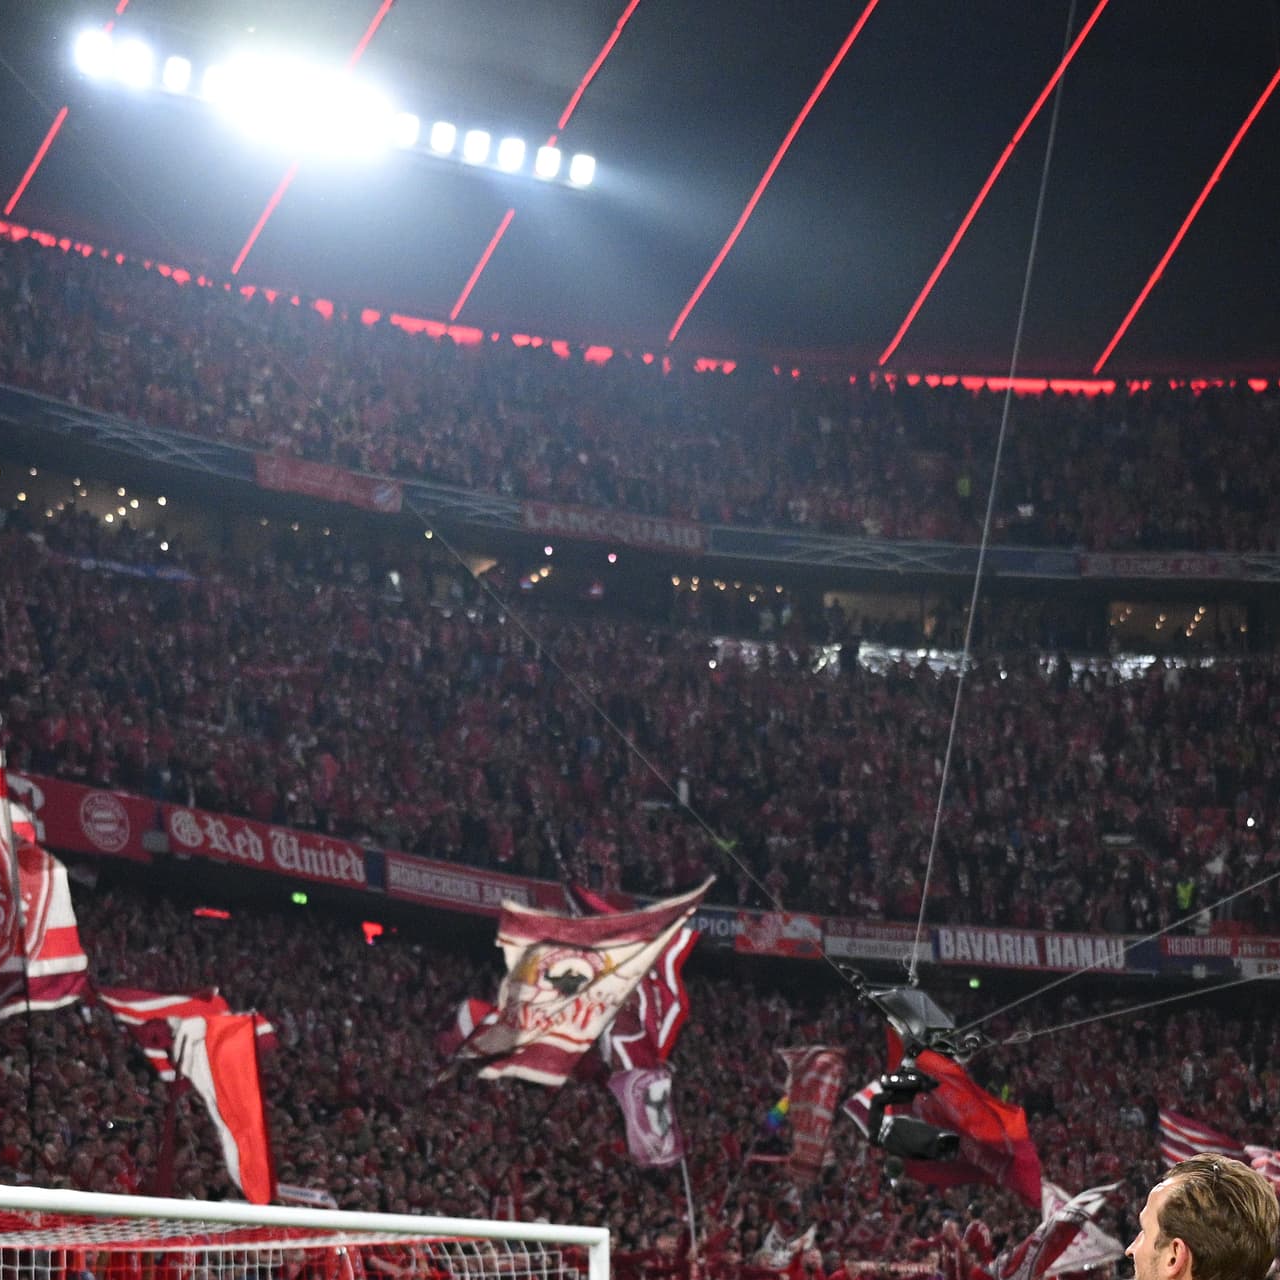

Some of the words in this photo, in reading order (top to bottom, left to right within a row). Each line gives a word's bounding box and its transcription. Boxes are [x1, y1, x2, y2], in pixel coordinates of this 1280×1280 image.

[270, 830, 366, 883] United
[938, 927, 1040, 967] BAVARIA
[1045, 934, 1125, 970] HANAU
